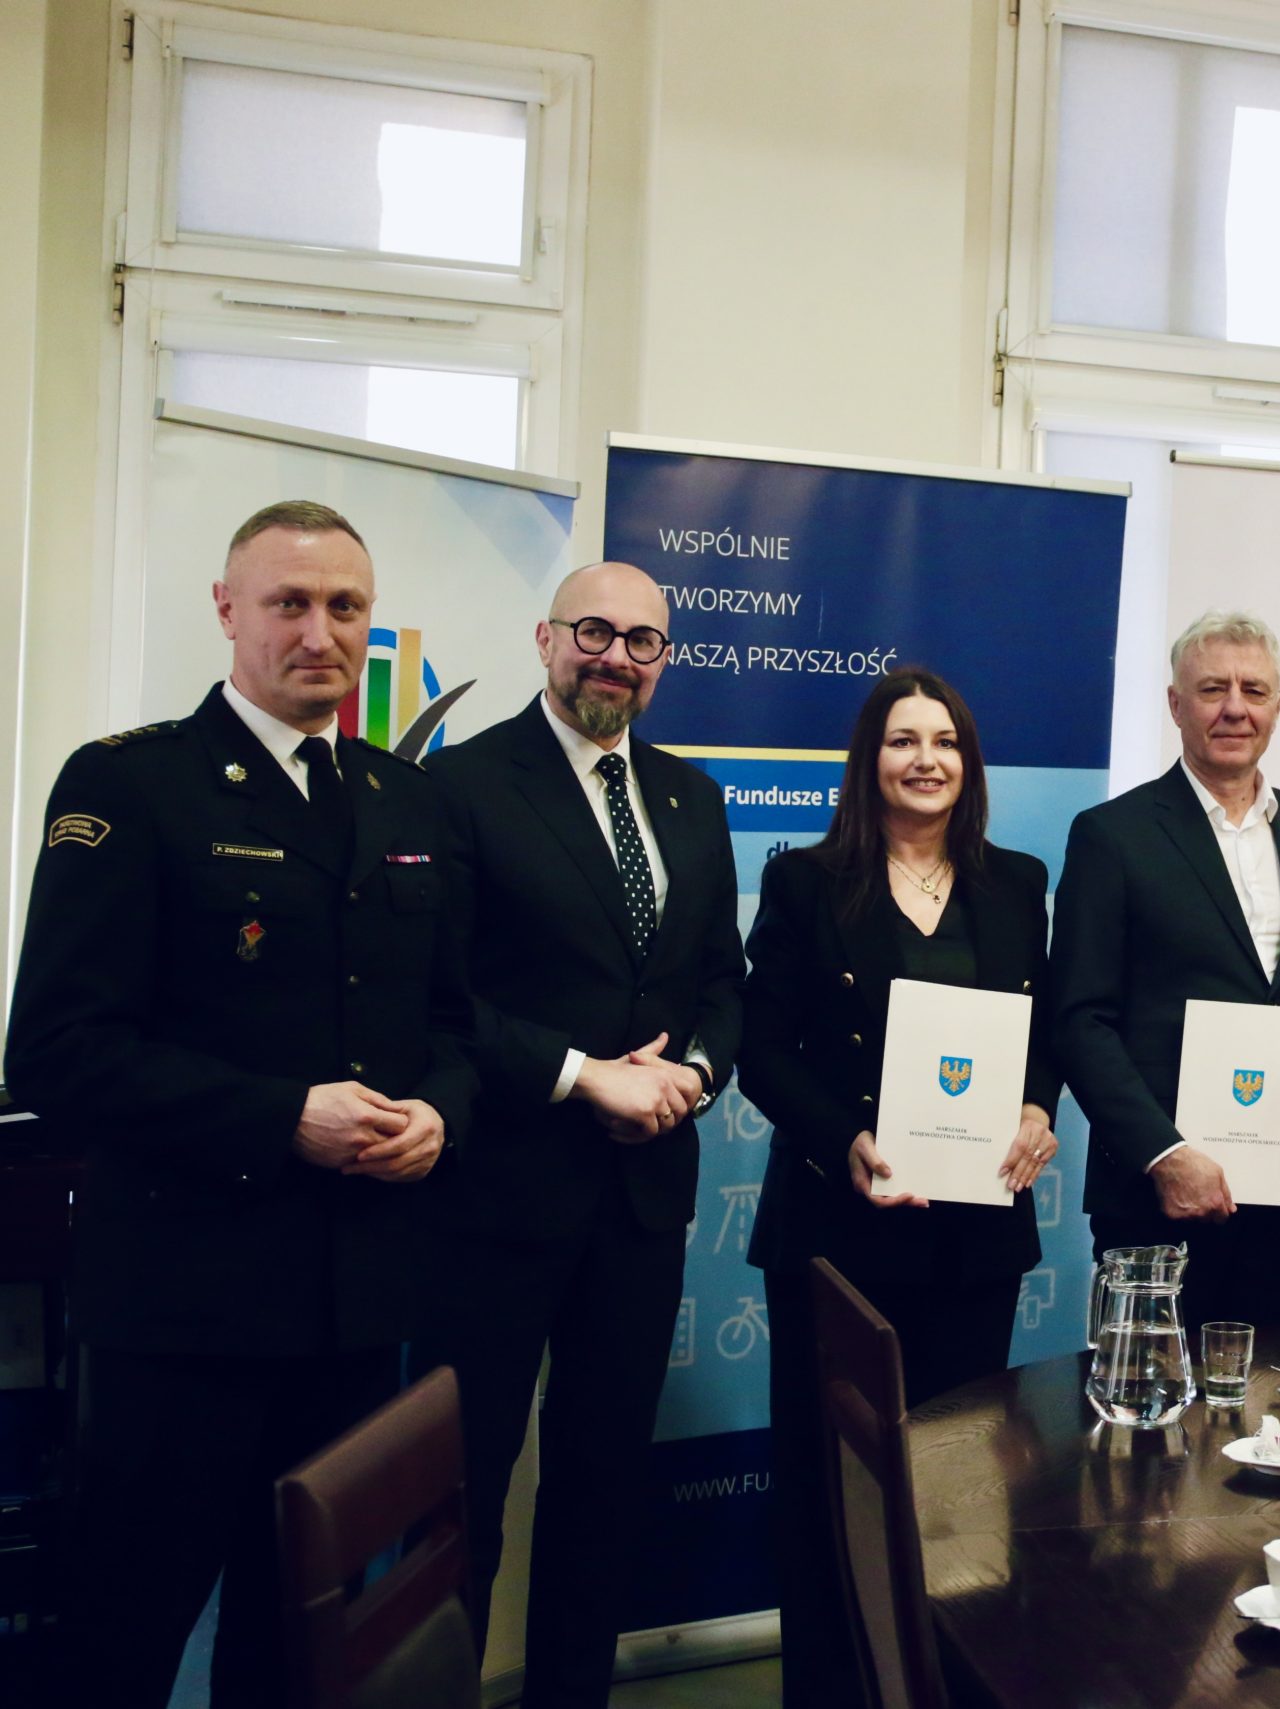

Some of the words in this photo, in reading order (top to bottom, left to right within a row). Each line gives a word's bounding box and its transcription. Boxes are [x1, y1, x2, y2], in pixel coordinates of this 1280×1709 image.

[659, 527, 790, 560] WSPÓLNIE
[658, 585, 802, 616] TWORZYMY
[748, 646, 897, 676] PRZYSZŁOŚĆ
[724, 785, 822, 806] Fundusze
